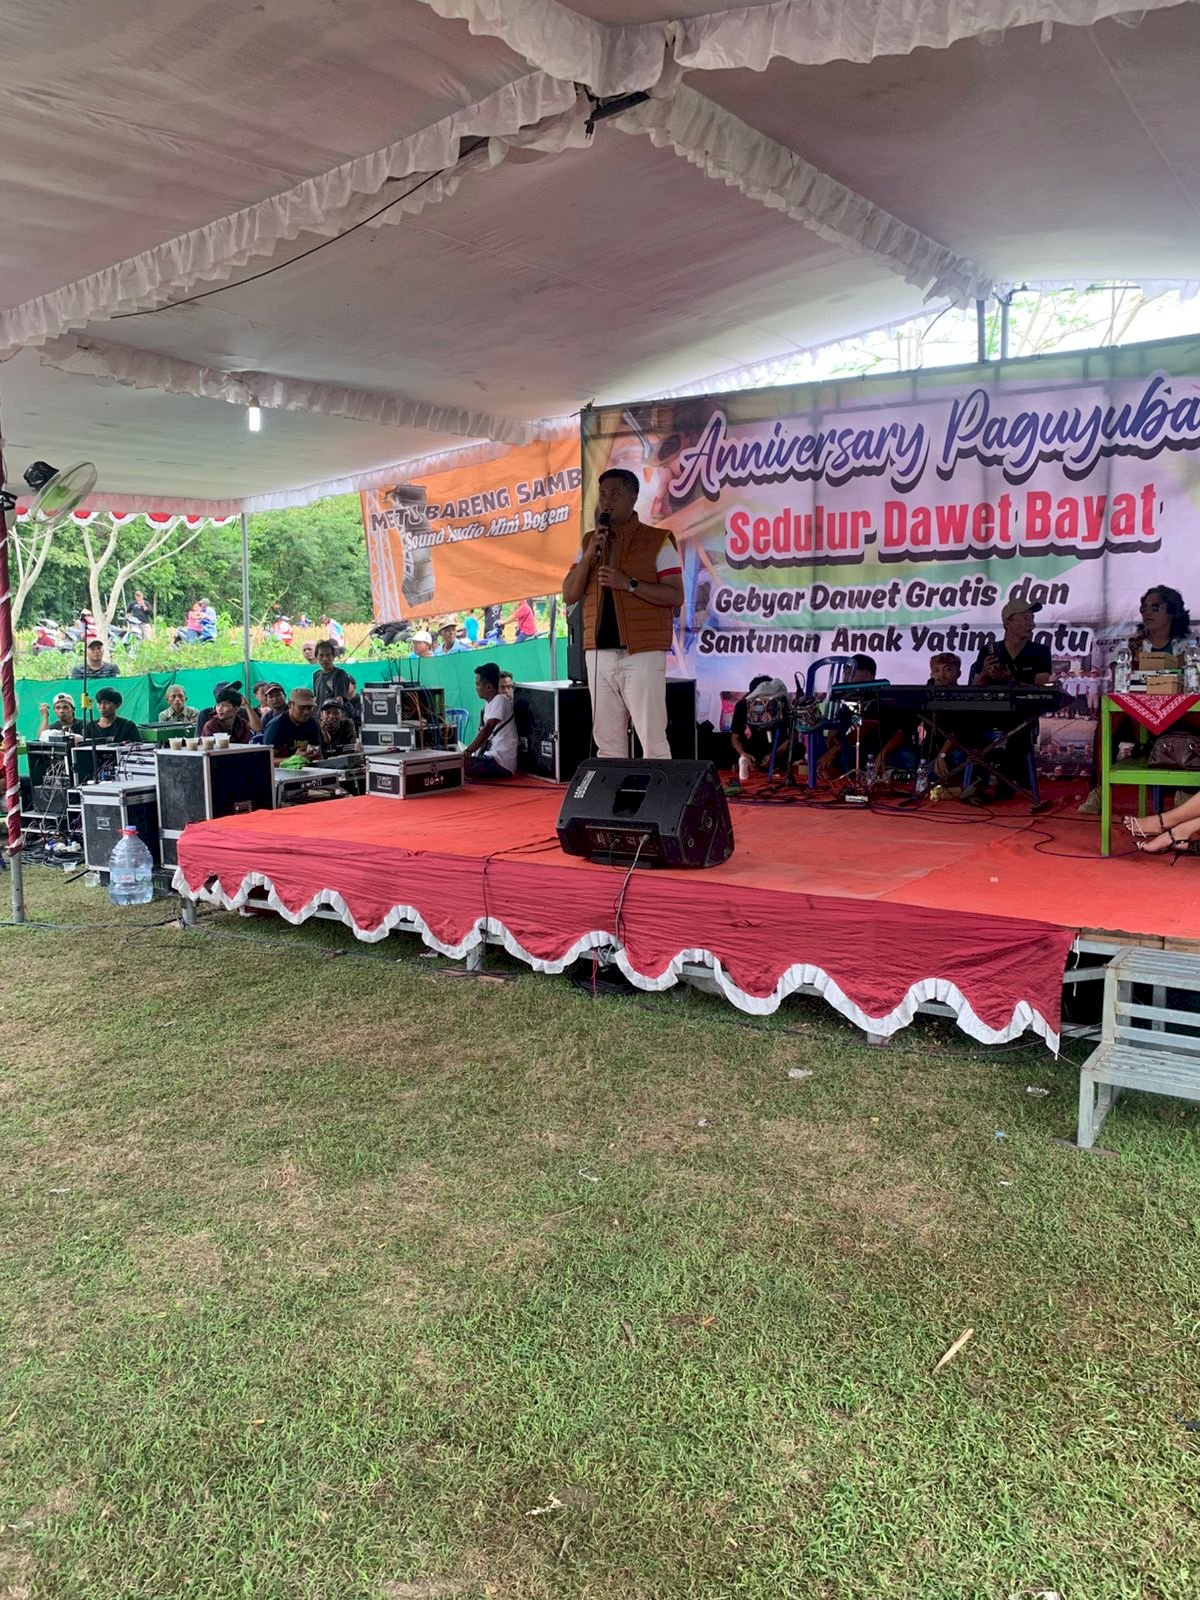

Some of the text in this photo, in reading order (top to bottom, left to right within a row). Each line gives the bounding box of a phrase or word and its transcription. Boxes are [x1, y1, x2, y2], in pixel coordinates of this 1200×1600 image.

[672, 376, 1200, 494] Anniversary Paguyuba
[425, 489, 509, 520] BARENG
[516, 468, 581, 503] SAMB
[405, 507, 569, 551] Sound Audio Mini Bogem
[729, 484, 1155, 555] Sedulur Dawet Bayat
[715, 577, 1070, 618] Gebyar Dawet Gratis dan
[699, 629, 821, 655] Santunan
[831, 626, 903, 653] Anak
[911, 623, 996, 652] Yatim
